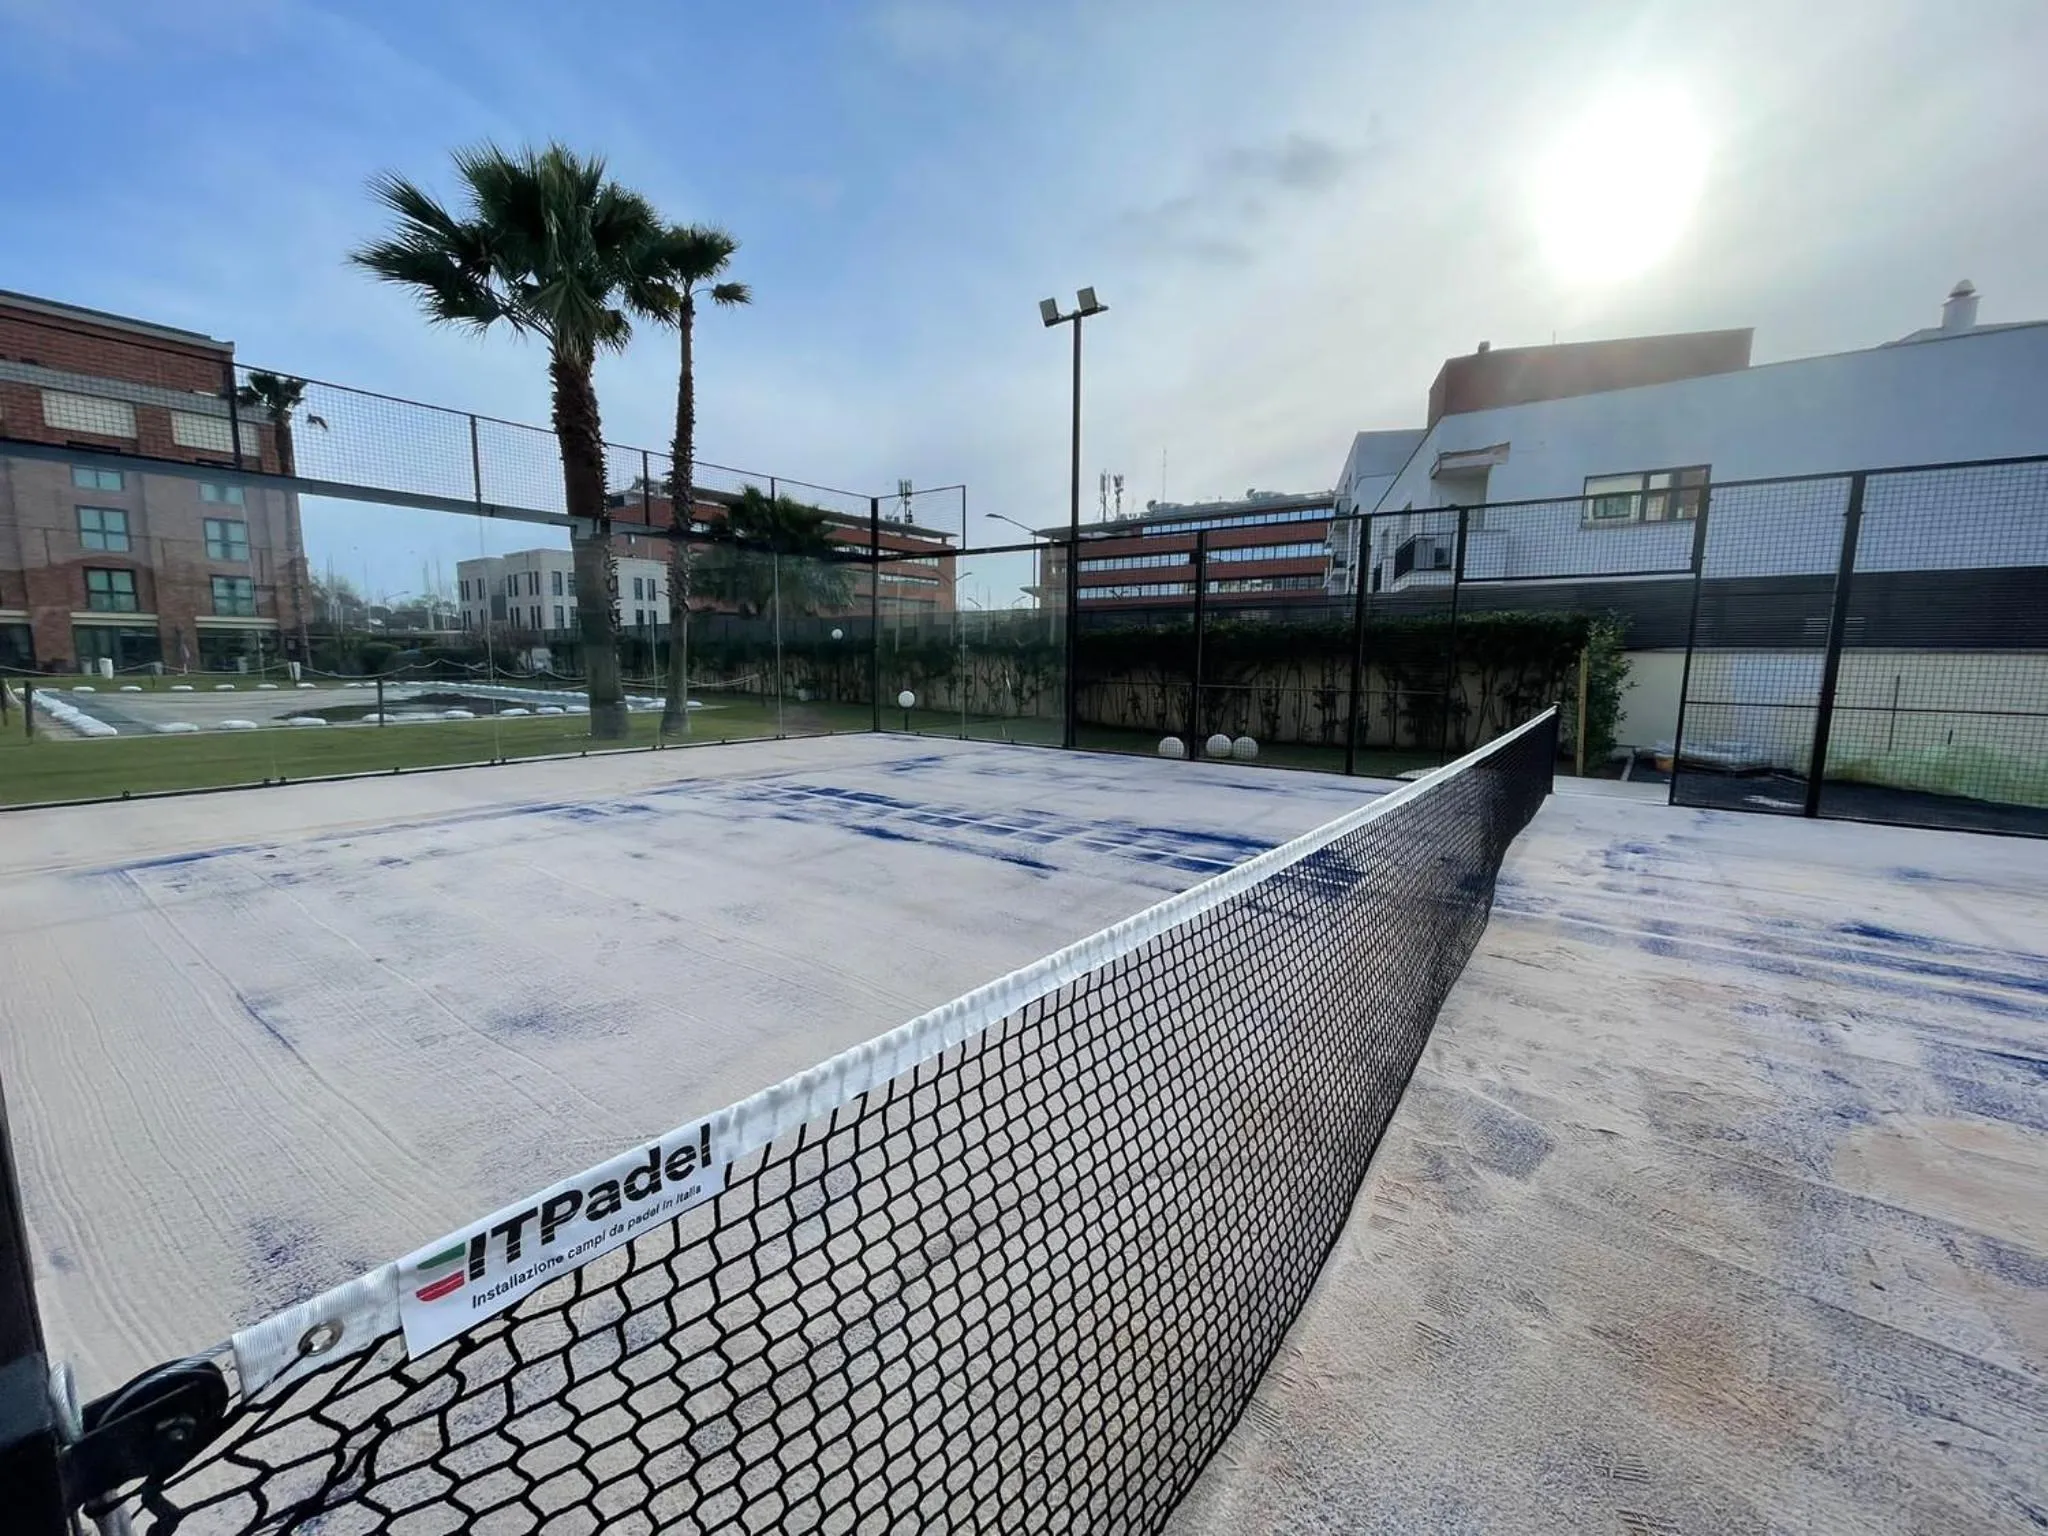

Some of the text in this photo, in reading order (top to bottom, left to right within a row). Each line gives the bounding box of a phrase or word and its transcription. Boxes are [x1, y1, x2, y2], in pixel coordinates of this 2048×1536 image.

[469, 1123, 712, 1281] ITPadel
[472, 1185, 701, 1309] Installazione campi da padel in Italia
